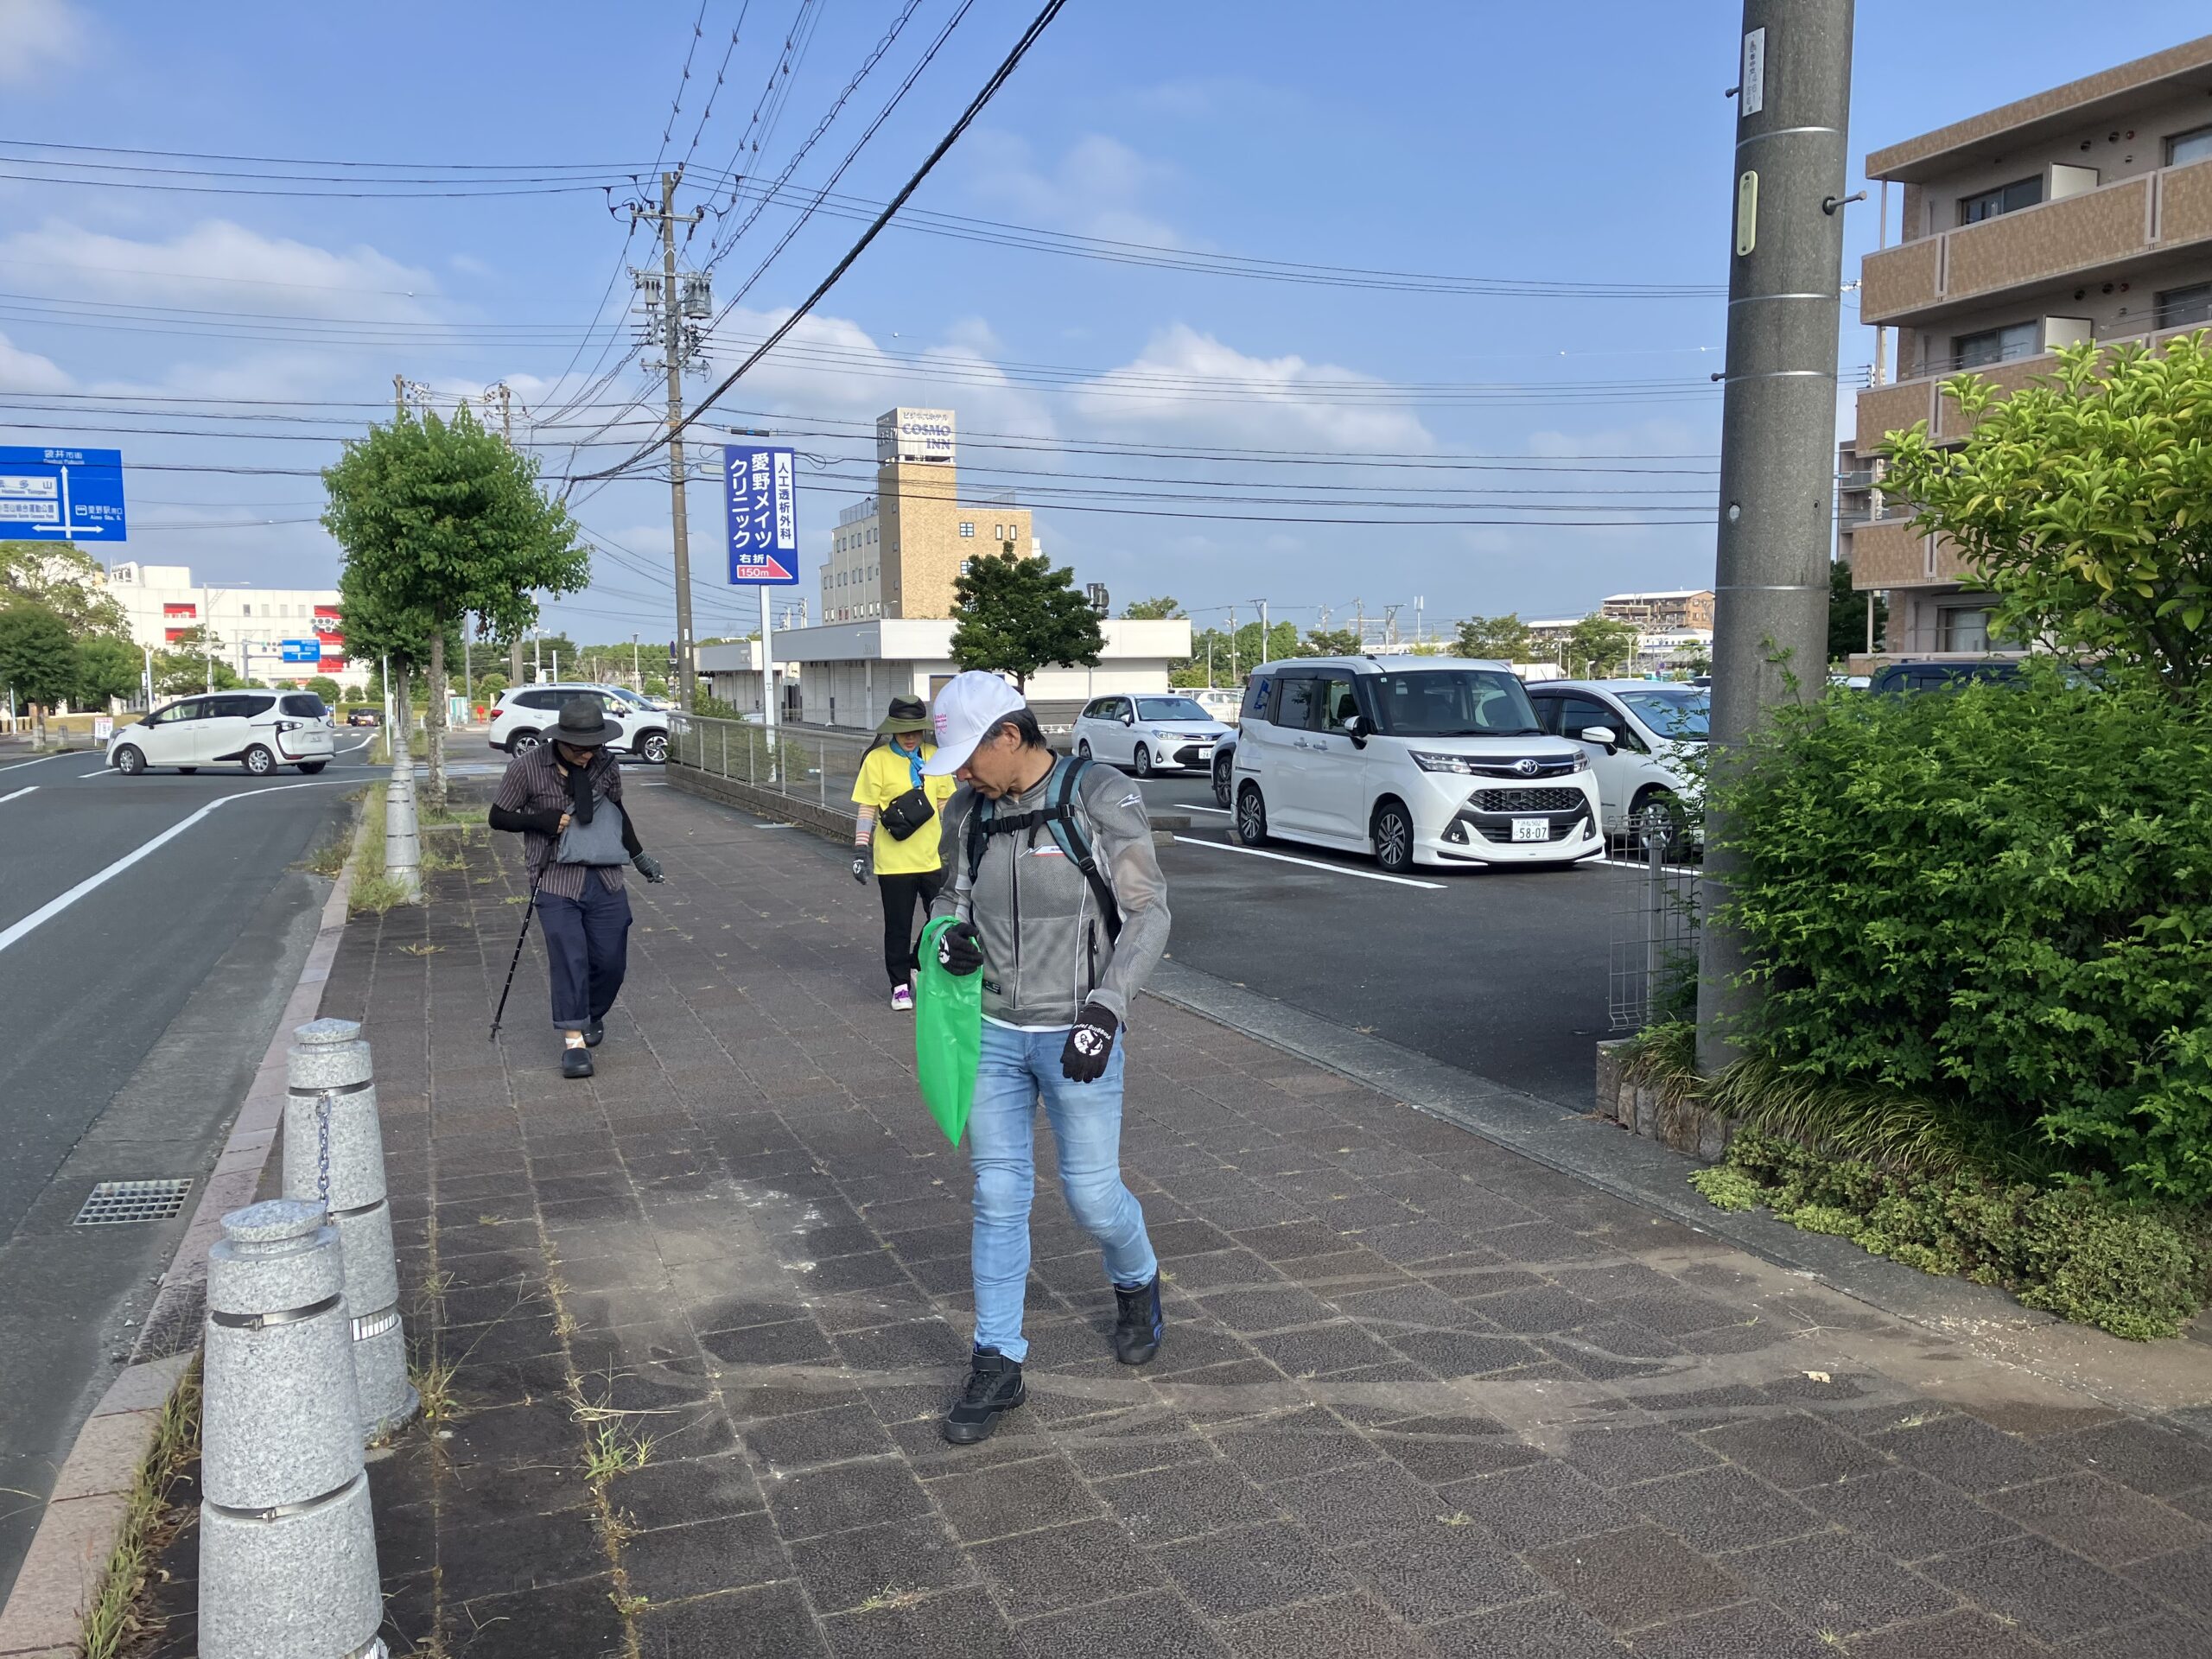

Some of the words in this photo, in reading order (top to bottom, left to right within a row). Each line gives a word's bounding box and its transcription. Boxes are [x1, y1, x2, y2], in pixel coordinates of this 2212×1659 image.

[902, 423, 951, 436] COSMO
[926, 438, 950, 449] INN
[730, 459, 750, 549] クリニック
[751, 452, 772, 549] 愛野メイツ
[778, 462, 791, 540] 人工透析外科
[740, 553, 764, 564] 右折
[741, 568, 769, 577] 150m
[1520, 827, 1547, 838] 58-07
